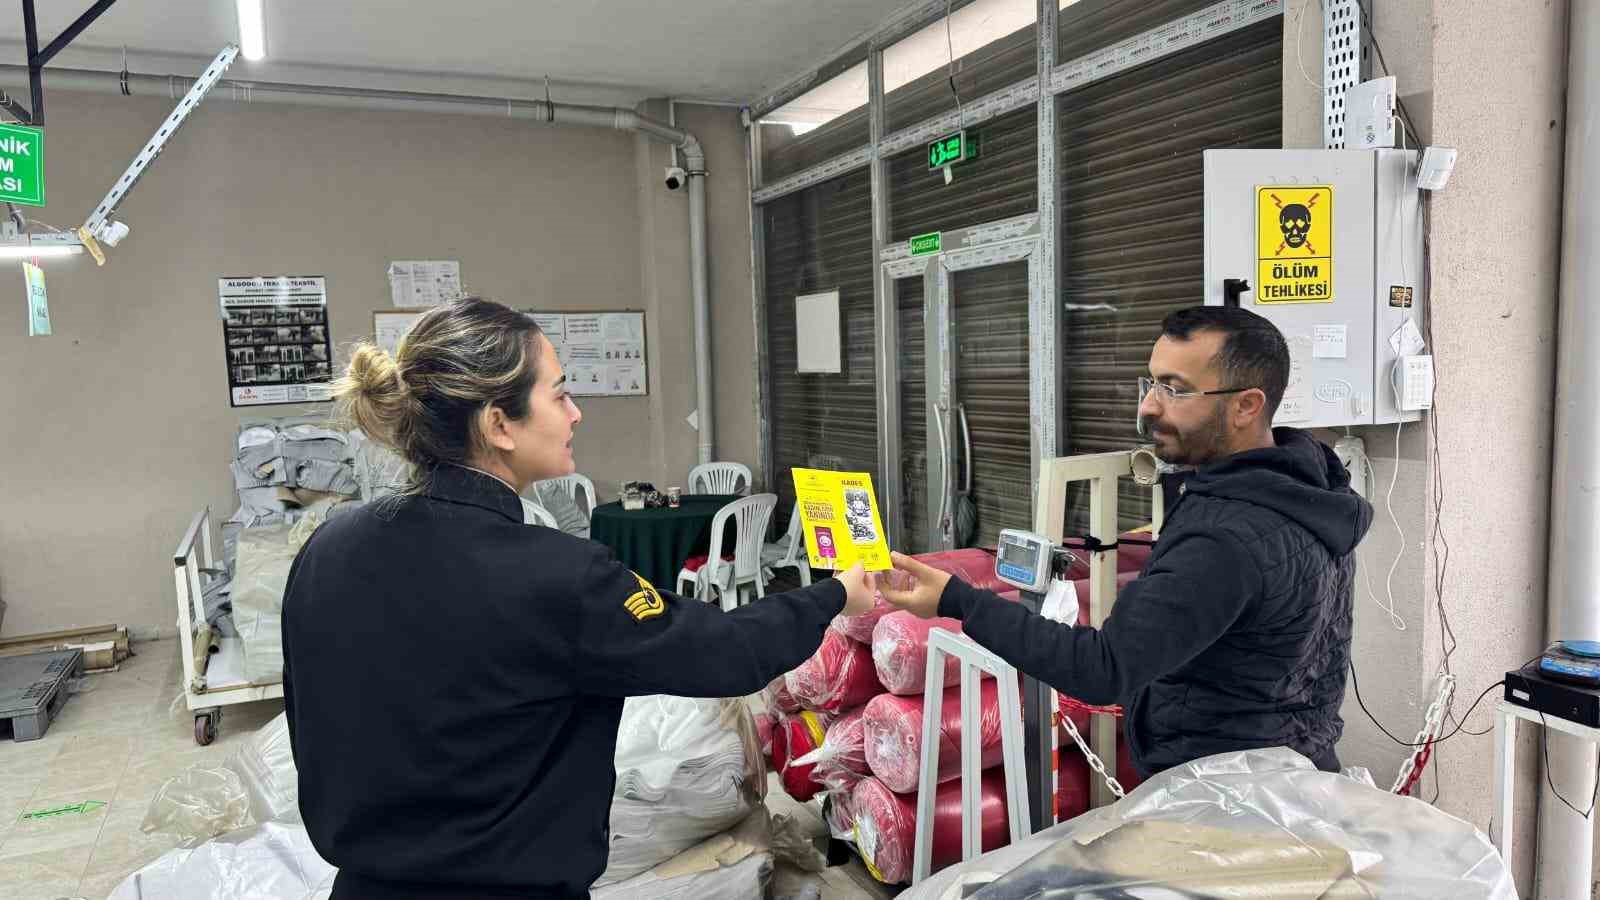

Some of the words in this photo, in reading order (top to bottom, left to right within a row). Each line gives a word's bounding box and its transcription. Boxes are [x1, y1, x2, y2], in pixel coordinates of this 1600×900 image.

[0, 136, 31, 156] NİK
[1272, 262, 1318, 279] ÖLÜM
[1263, 280, 1328, 297] TEHLİKESİ
